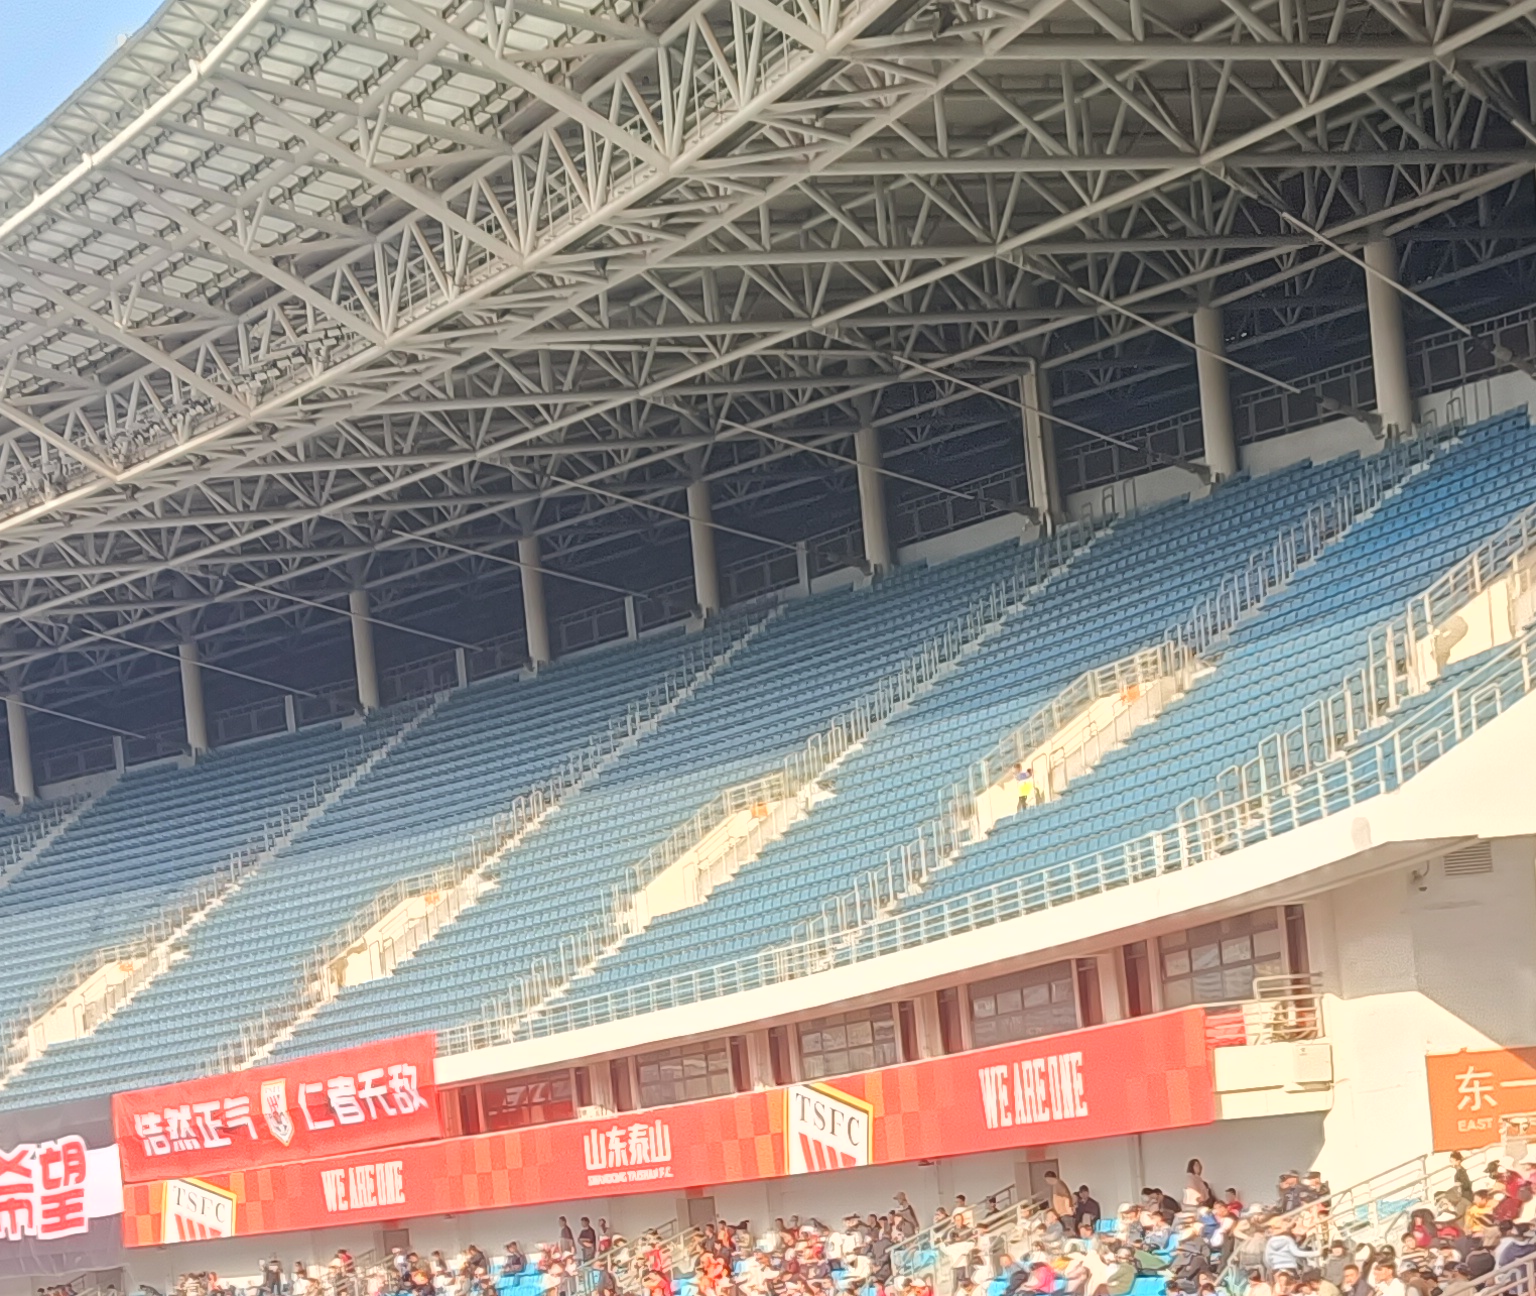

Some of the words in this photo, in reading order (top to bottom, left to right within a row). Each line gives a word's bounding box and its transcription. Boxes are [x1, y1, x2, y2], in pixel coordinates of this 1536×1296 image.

[134, 1096, 258, 1156] 浩然正气
[298, 1063, 429, 1131] 仁者无敌
[979, 1065, 1012, 1129] WE
[1014, 1058, 1050, 1125] ARE
[1047, 1051, 1088, 1120] ONE
[583, 1119, 671, 1170] 山东泰山
[795, 1092, 861, 1146] TSFC
[1458, 1117, 1493, 1132] EAST
[172, 1186, 226, 1223] TSFC
[321, 1169, 348, 1212] WE
[349, 1165, 377, 1209] ARE
[376, 1161, 405, 1205] ONE
